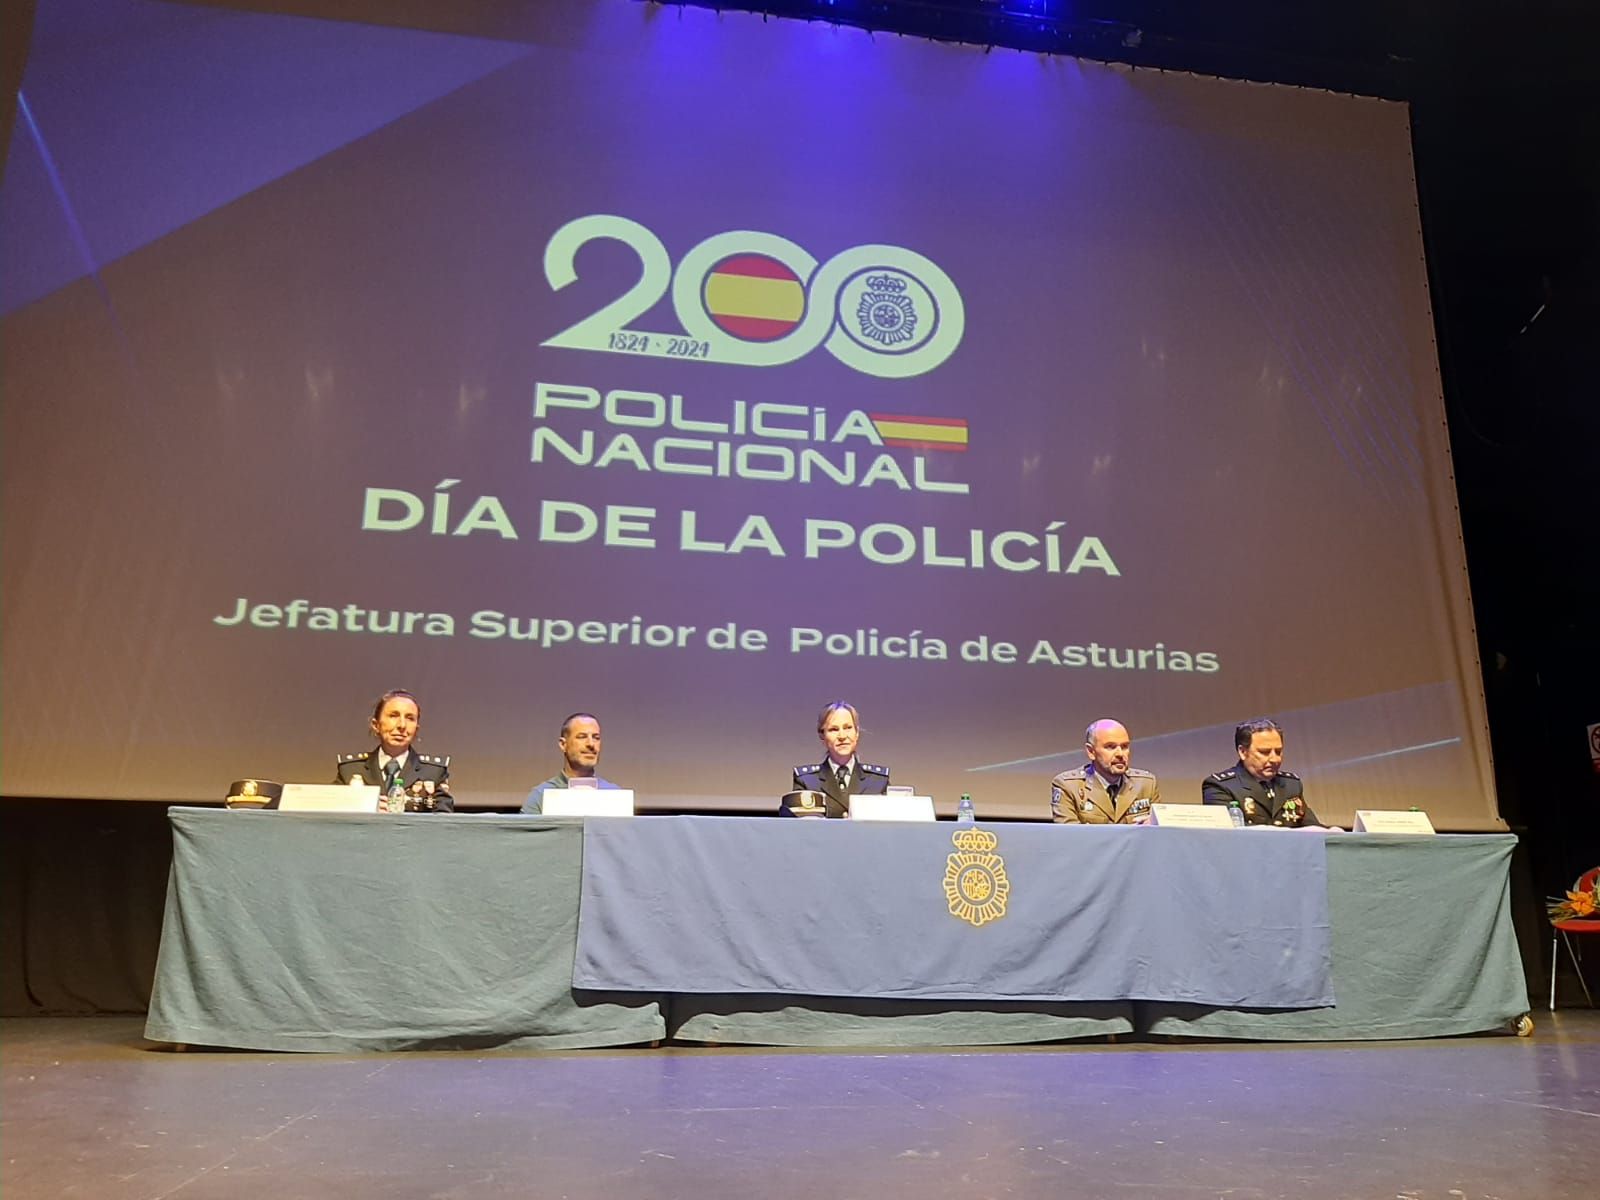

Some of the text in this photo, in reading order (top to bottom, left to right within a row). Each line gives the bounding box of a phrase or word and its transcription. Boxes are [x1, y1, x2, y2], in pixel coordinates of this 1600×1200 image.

[539, 213, 966, 379] 200
[531, 427, 970, 494] NACIONAL
[362, 478, 1121, 577] DÍA DE LA POLICÍA
[213, 597, 1221, 673] Jefatura Superior de Policía de Asturias
